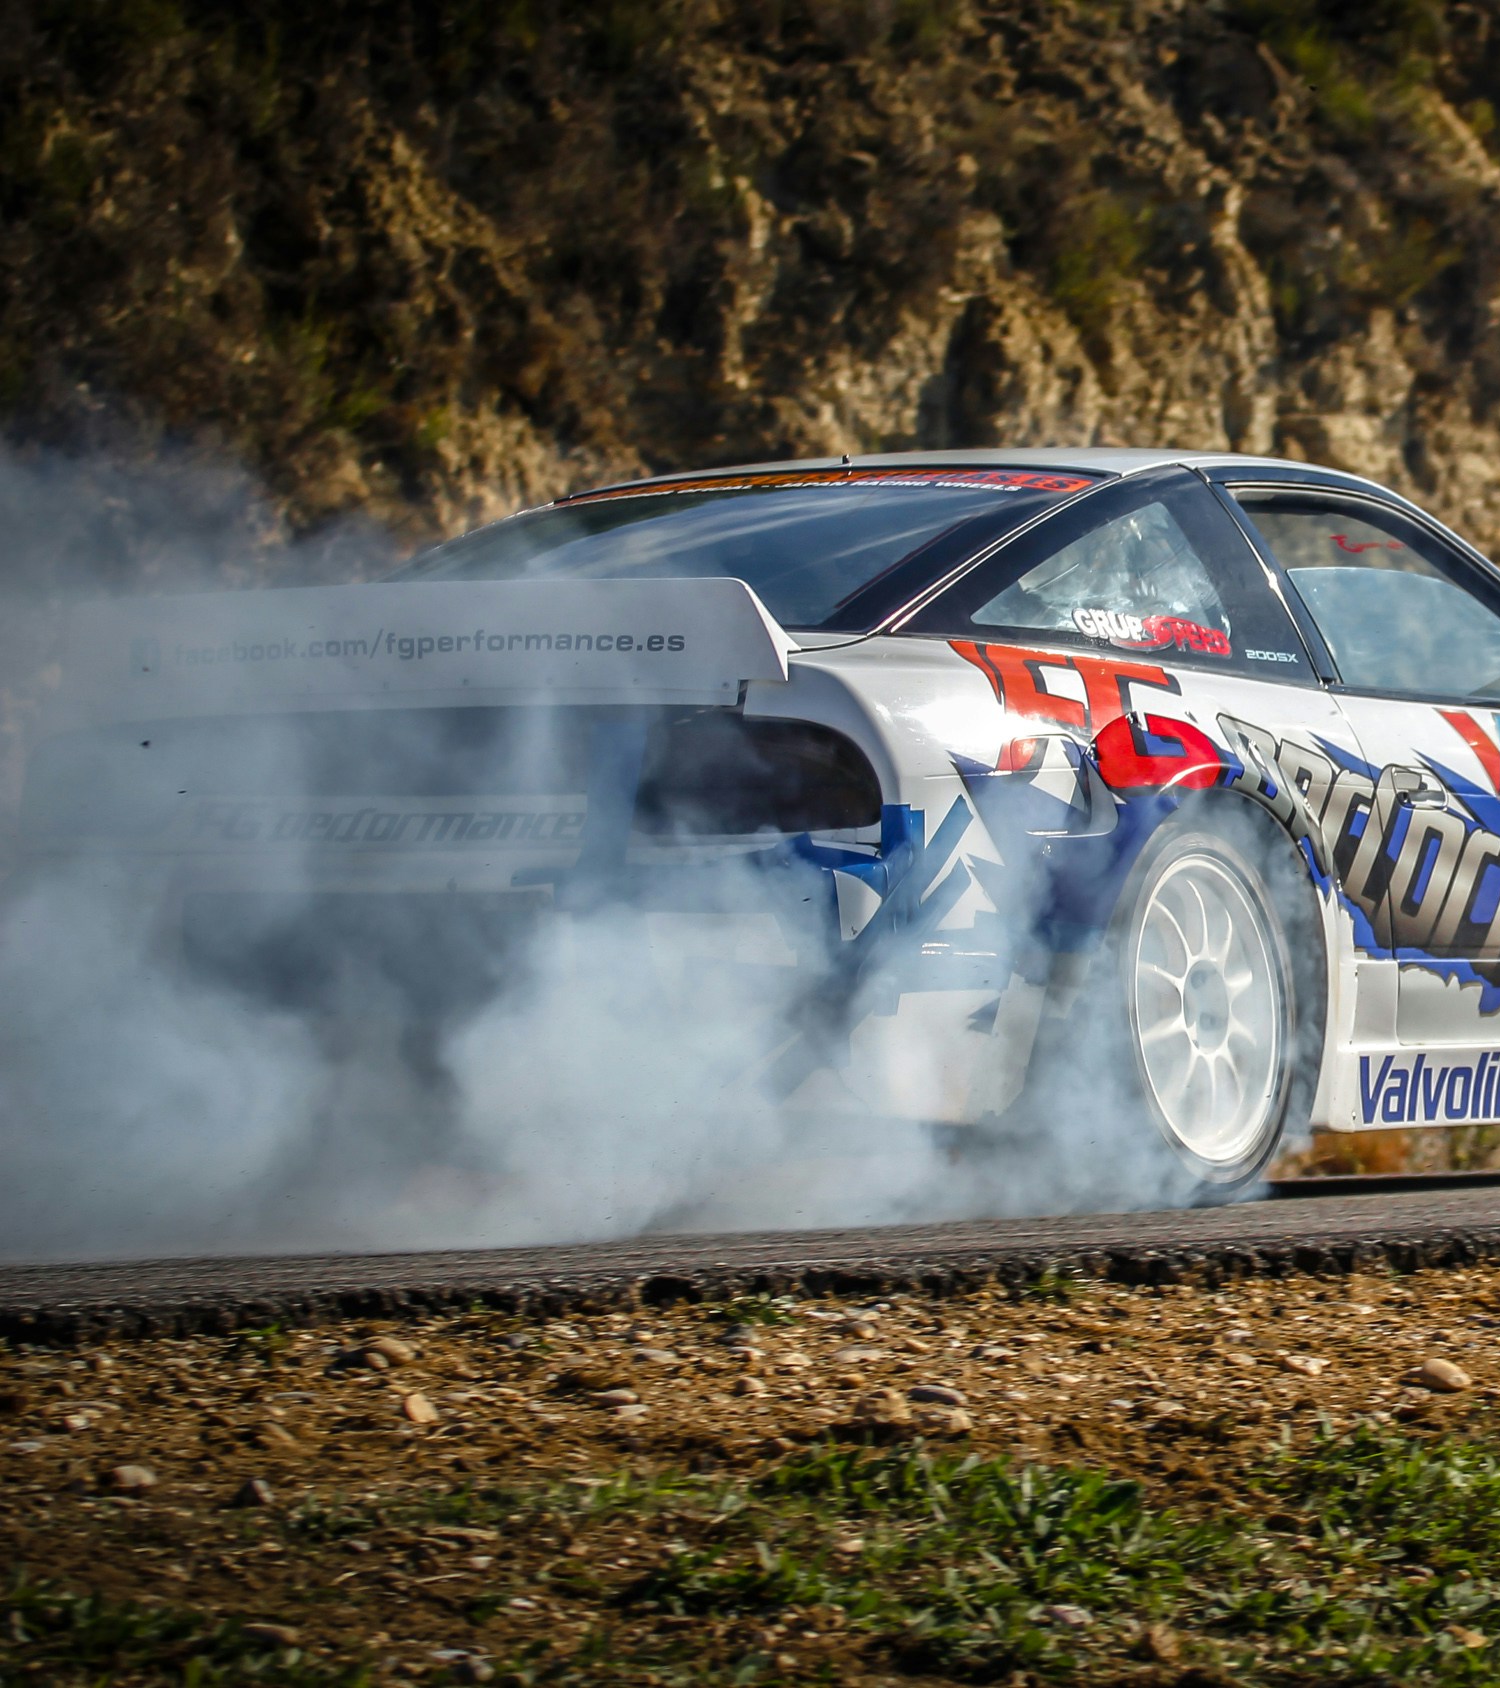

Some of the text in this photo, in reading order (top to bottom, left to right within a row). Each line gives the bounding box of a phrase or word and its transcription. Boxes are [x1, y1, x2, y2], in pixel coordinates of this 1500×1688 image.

[934, 480, 1022, 492] WHEELS
[1245, 649, 1299, 663] 200SX
[271, 807, 588, 843] performance
